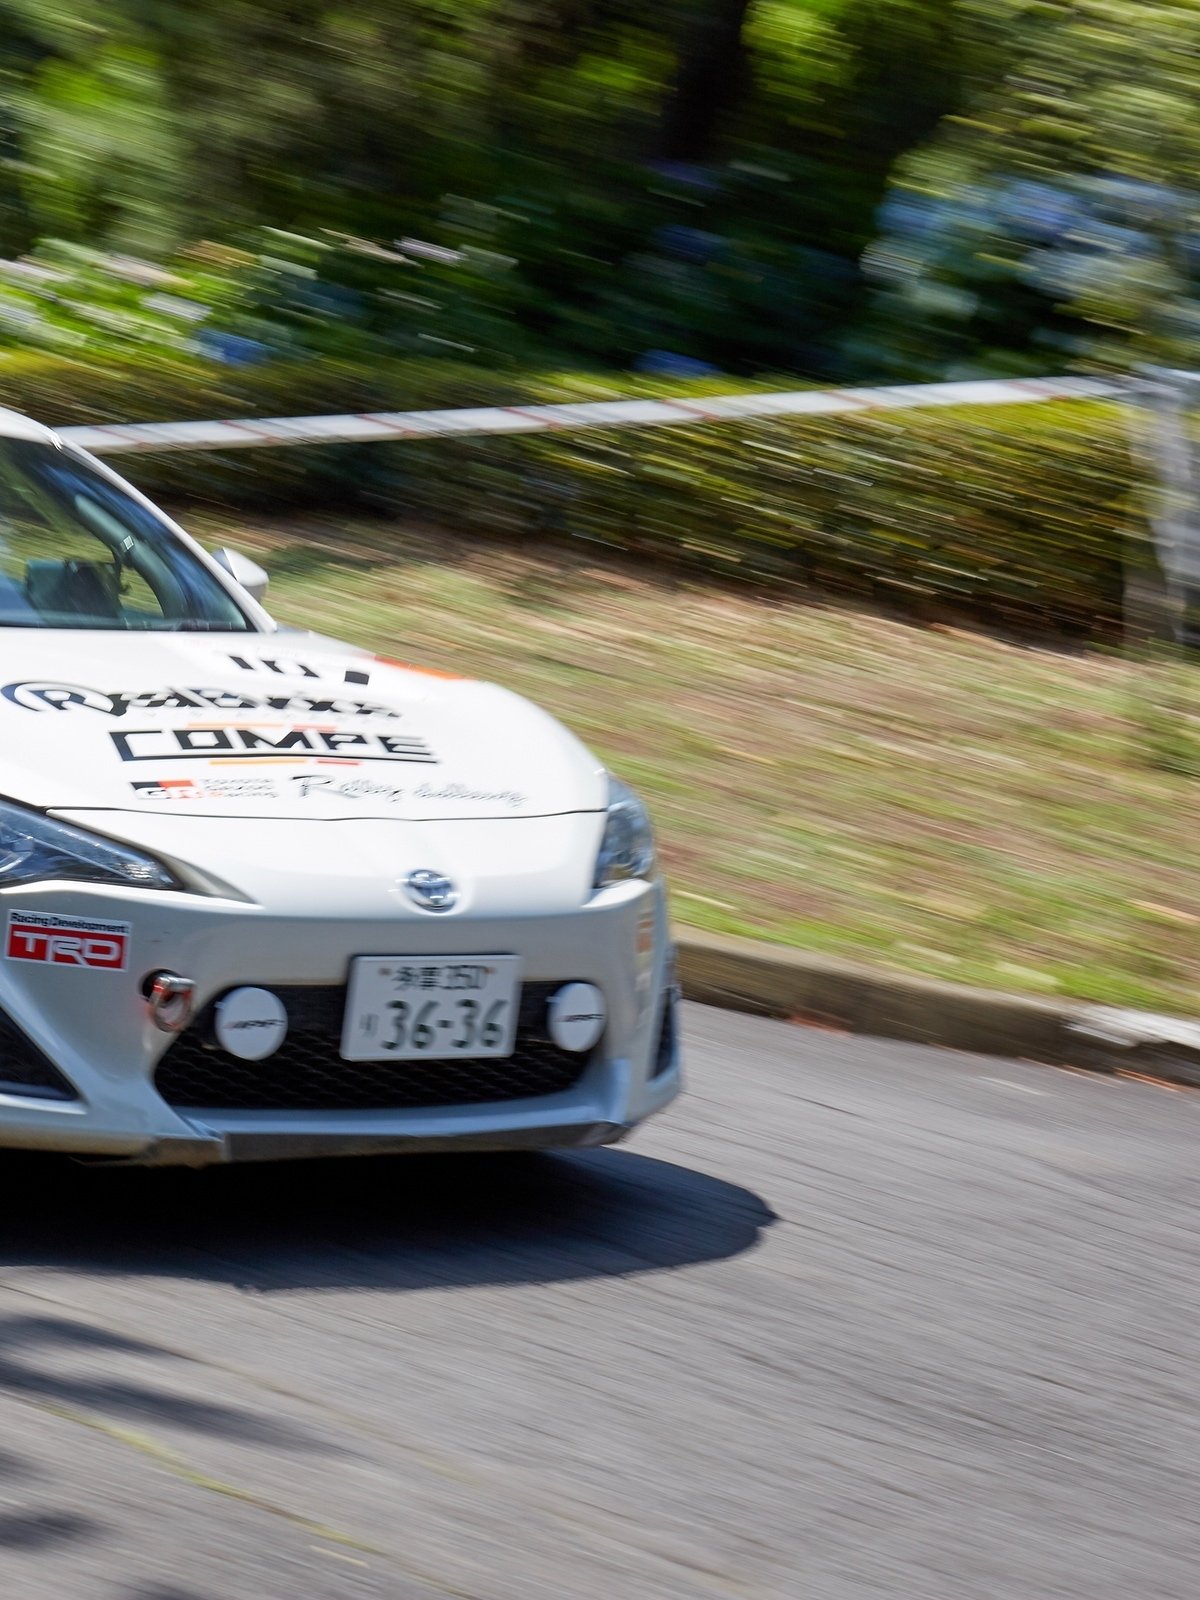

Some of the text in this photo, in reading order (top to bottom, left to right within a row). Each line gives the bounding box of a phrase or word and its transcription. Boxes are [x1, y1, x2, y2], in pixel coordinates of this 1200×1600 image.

[10, 912, 50, 927] Racing
[12, 930, 121, 966] TRD
[381, 999, 509, 1050] 36-36
